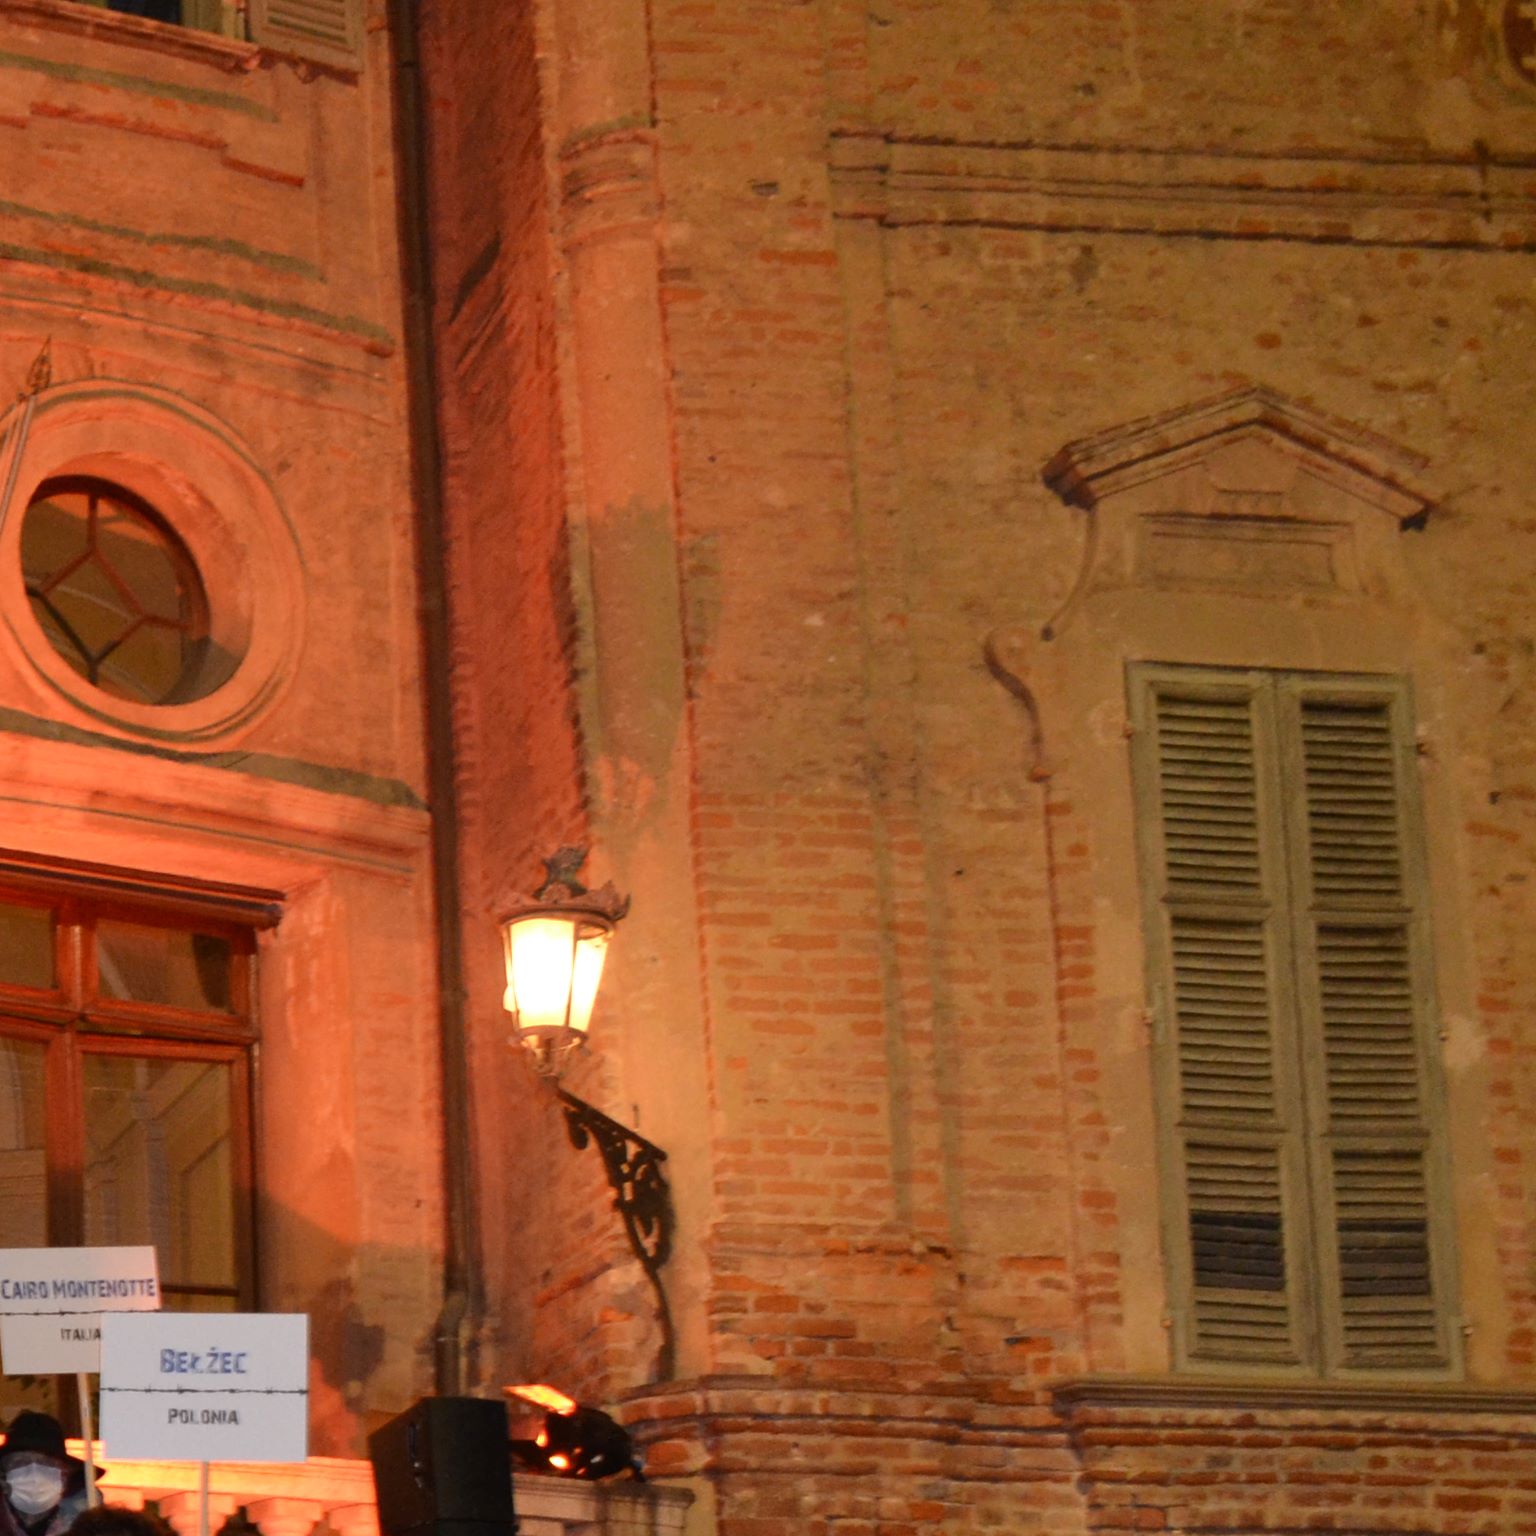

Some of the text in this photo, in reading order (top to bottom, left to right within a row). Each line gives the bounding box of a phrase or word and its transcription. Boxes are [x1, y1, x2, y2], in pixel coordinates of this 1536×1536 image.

[1, 1278, 156, 1299] CAIRO MONTENOTTE
[61, 1327, 102, 1341] ITALIA
[168, 1408, 239, 1425] POLONIA
